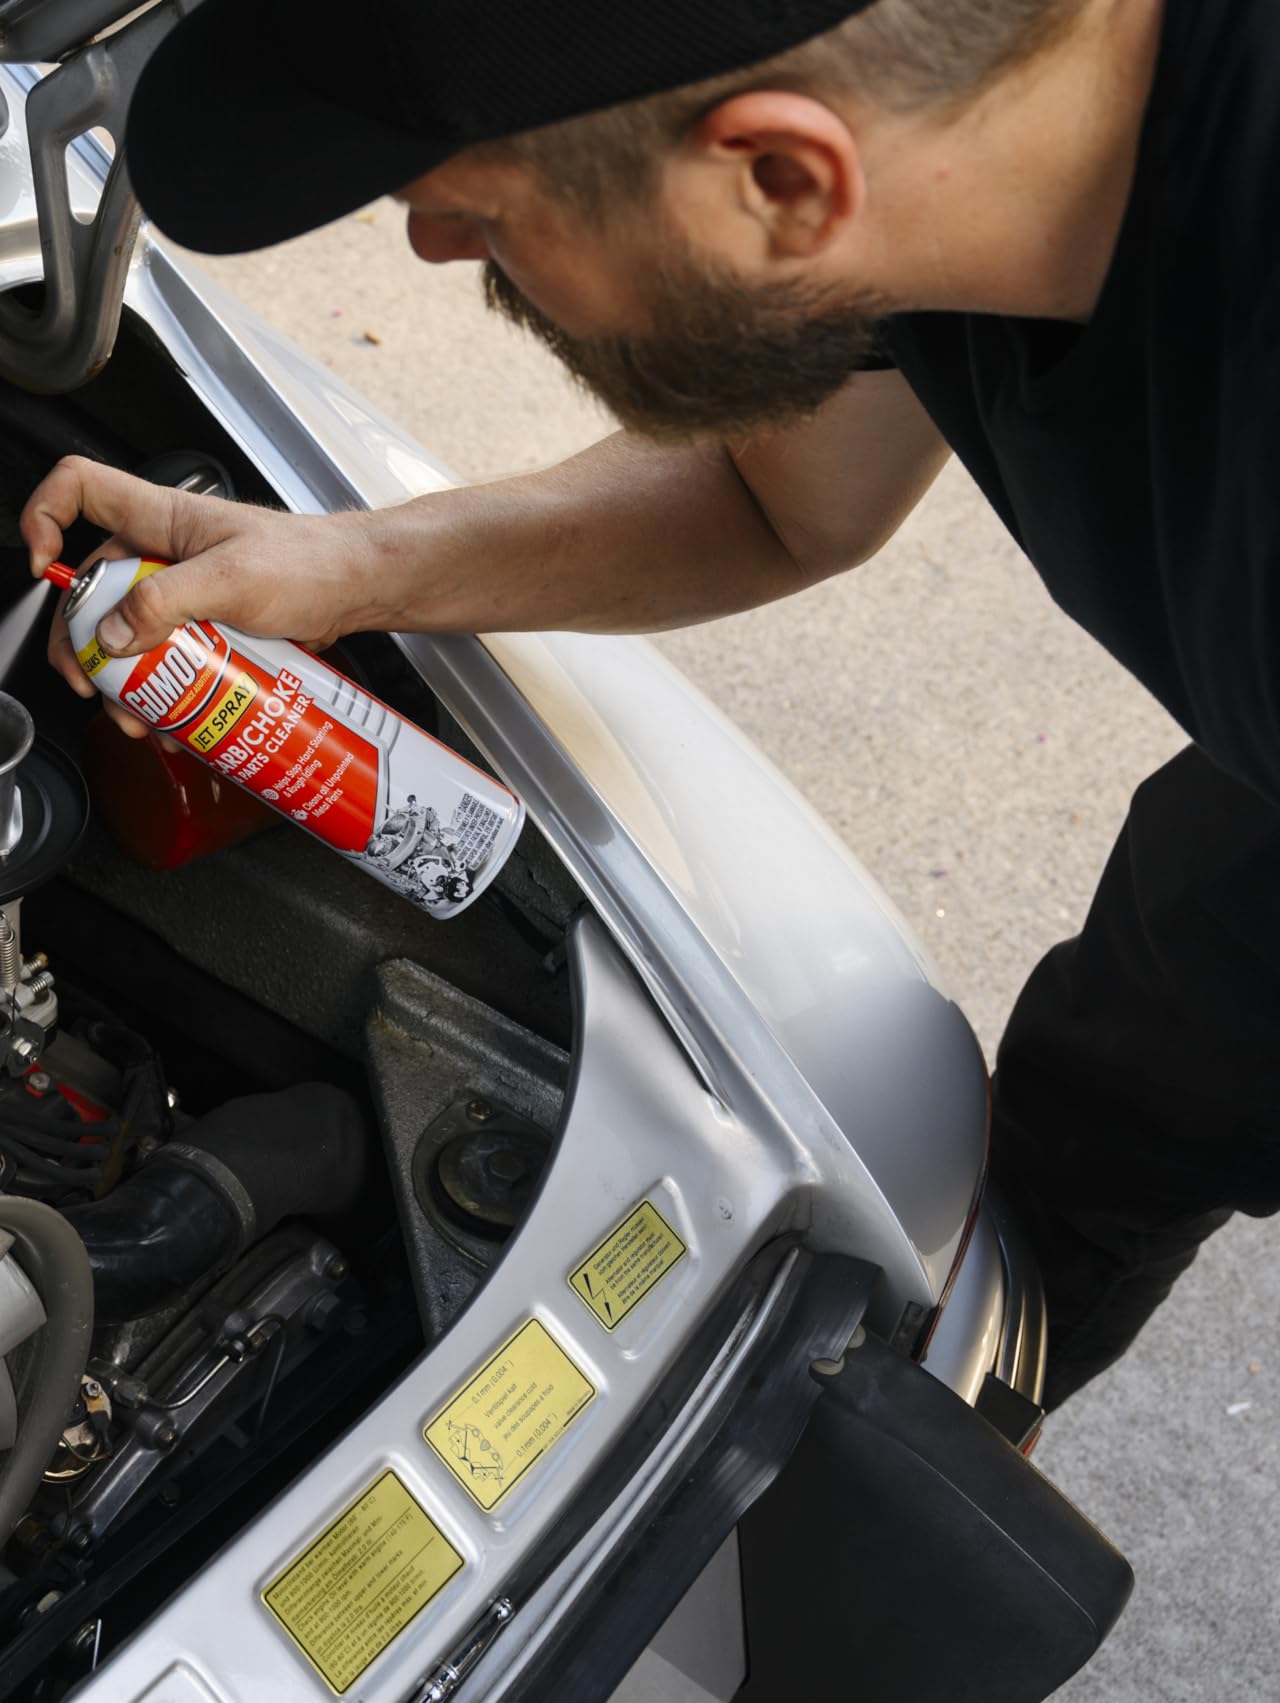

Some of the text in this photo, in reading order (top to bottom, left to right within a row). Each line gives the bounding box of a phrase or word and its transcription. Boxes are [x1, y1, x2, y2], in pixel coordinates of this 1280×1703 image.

[124, 618, 217, 724] GUMOUT
[167, 690, 197, 721] PERFORMANCE
[193, 678, 255, 749] JET SPRAY
[208, 668, 301, 775] CARB/CHOKE
[238, 750, 270, 781] PARTS
[263, 693, 312, 754] CLEANER
[272, 718, 334, 790] Helps Stop Hard Starting
[283, 757, 322, 798] & Rough Idling
[302, 750, 357, 813] Cleans all Unpainted
[312, 785, 344, 819] Metal Parts
[492, 1381, 537, 1429] valve clearance cold
[332, 1523, 348, 1540] Motor
